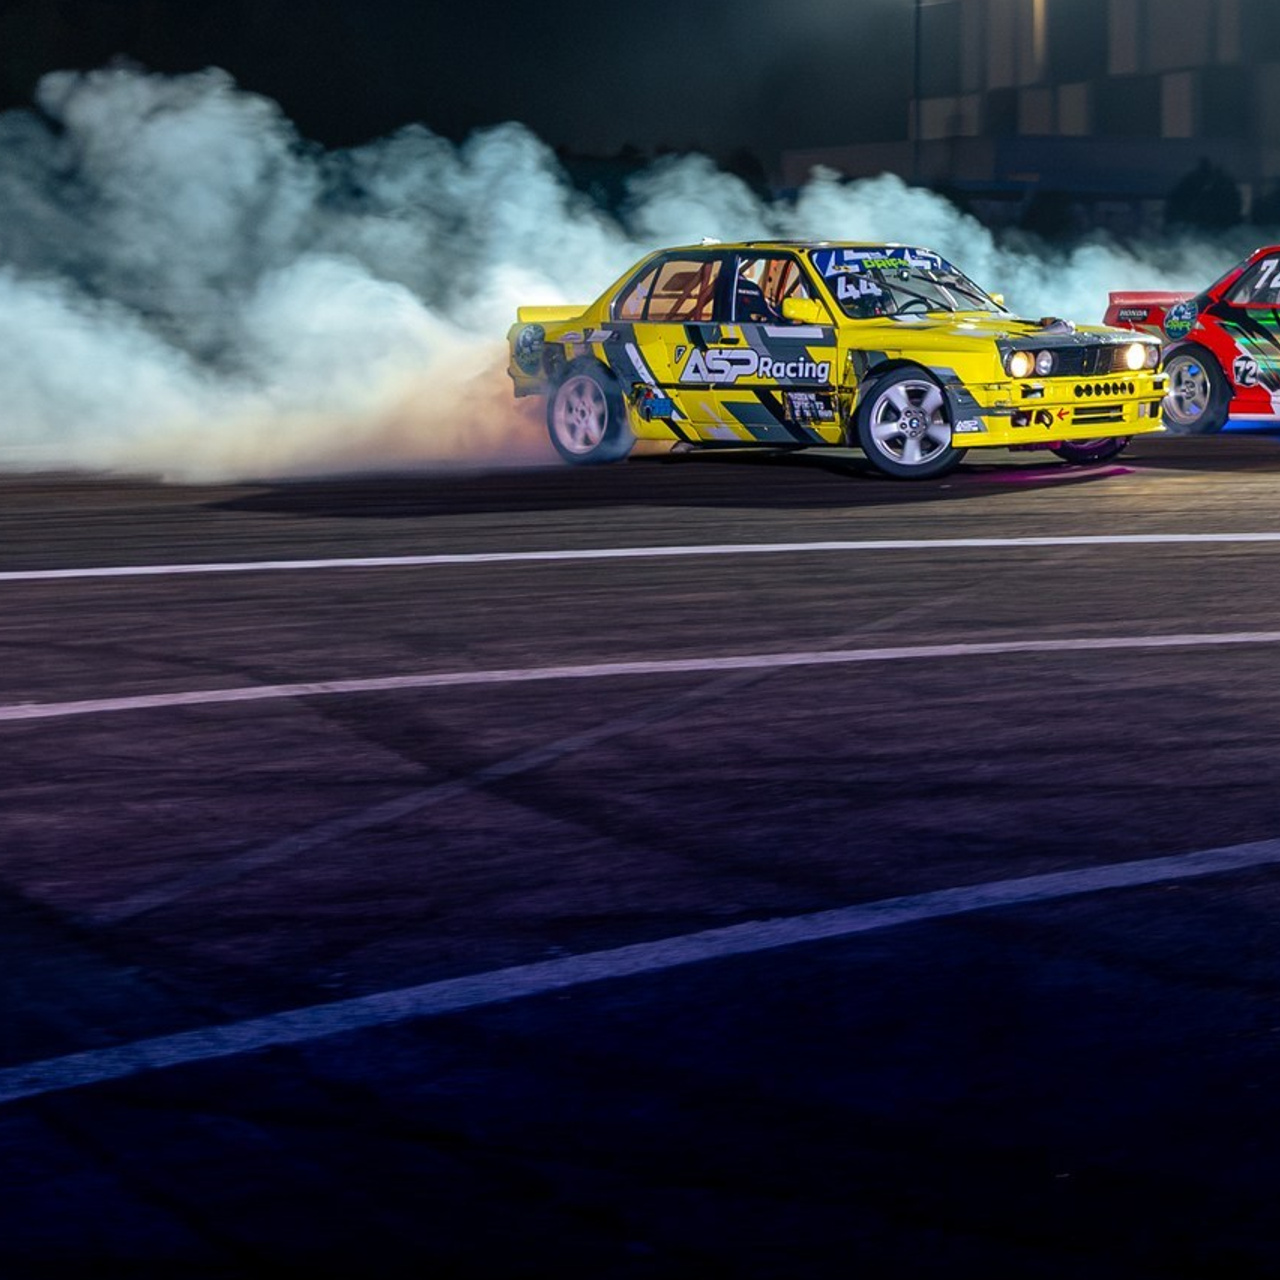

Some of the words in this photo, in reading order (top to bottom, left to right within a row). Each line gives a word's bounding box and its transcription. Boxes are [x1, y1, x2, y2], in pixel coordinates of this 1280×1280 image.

[837, 276, 882, 300] 44
[1119, 309, 1148, 317] HONDA
[679, 347, 759, 383] ASP
[757, 356, 830, 384] Racing
[1234, 361, 1257, 384] 72
